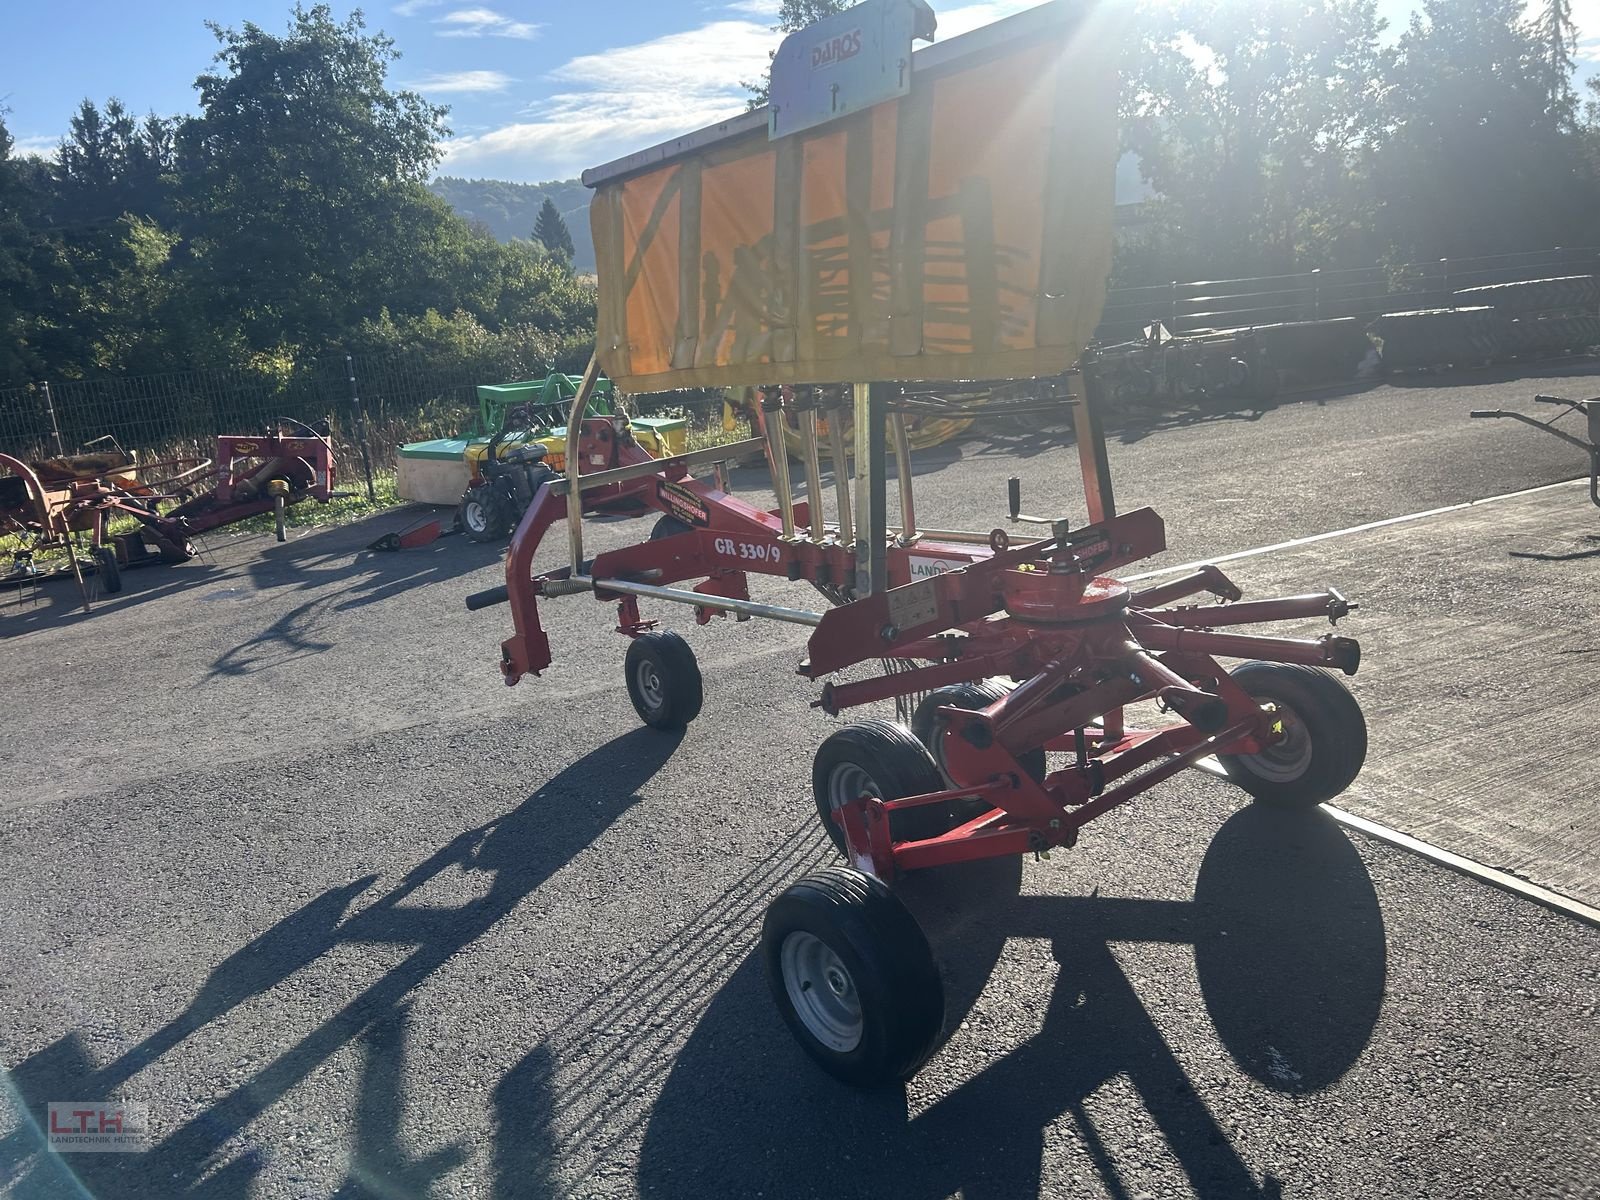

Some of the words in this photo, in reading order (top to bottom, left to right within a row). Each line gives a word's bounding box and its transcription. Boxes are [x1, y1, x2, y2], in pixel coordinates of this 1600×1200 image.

[811, 29, 862, 66] DAROS
[660, 487, 707, 521] WILLINGSHOFER
[714, 538, 736, 556] GR
[739, 543, 781, 563] 330/9
